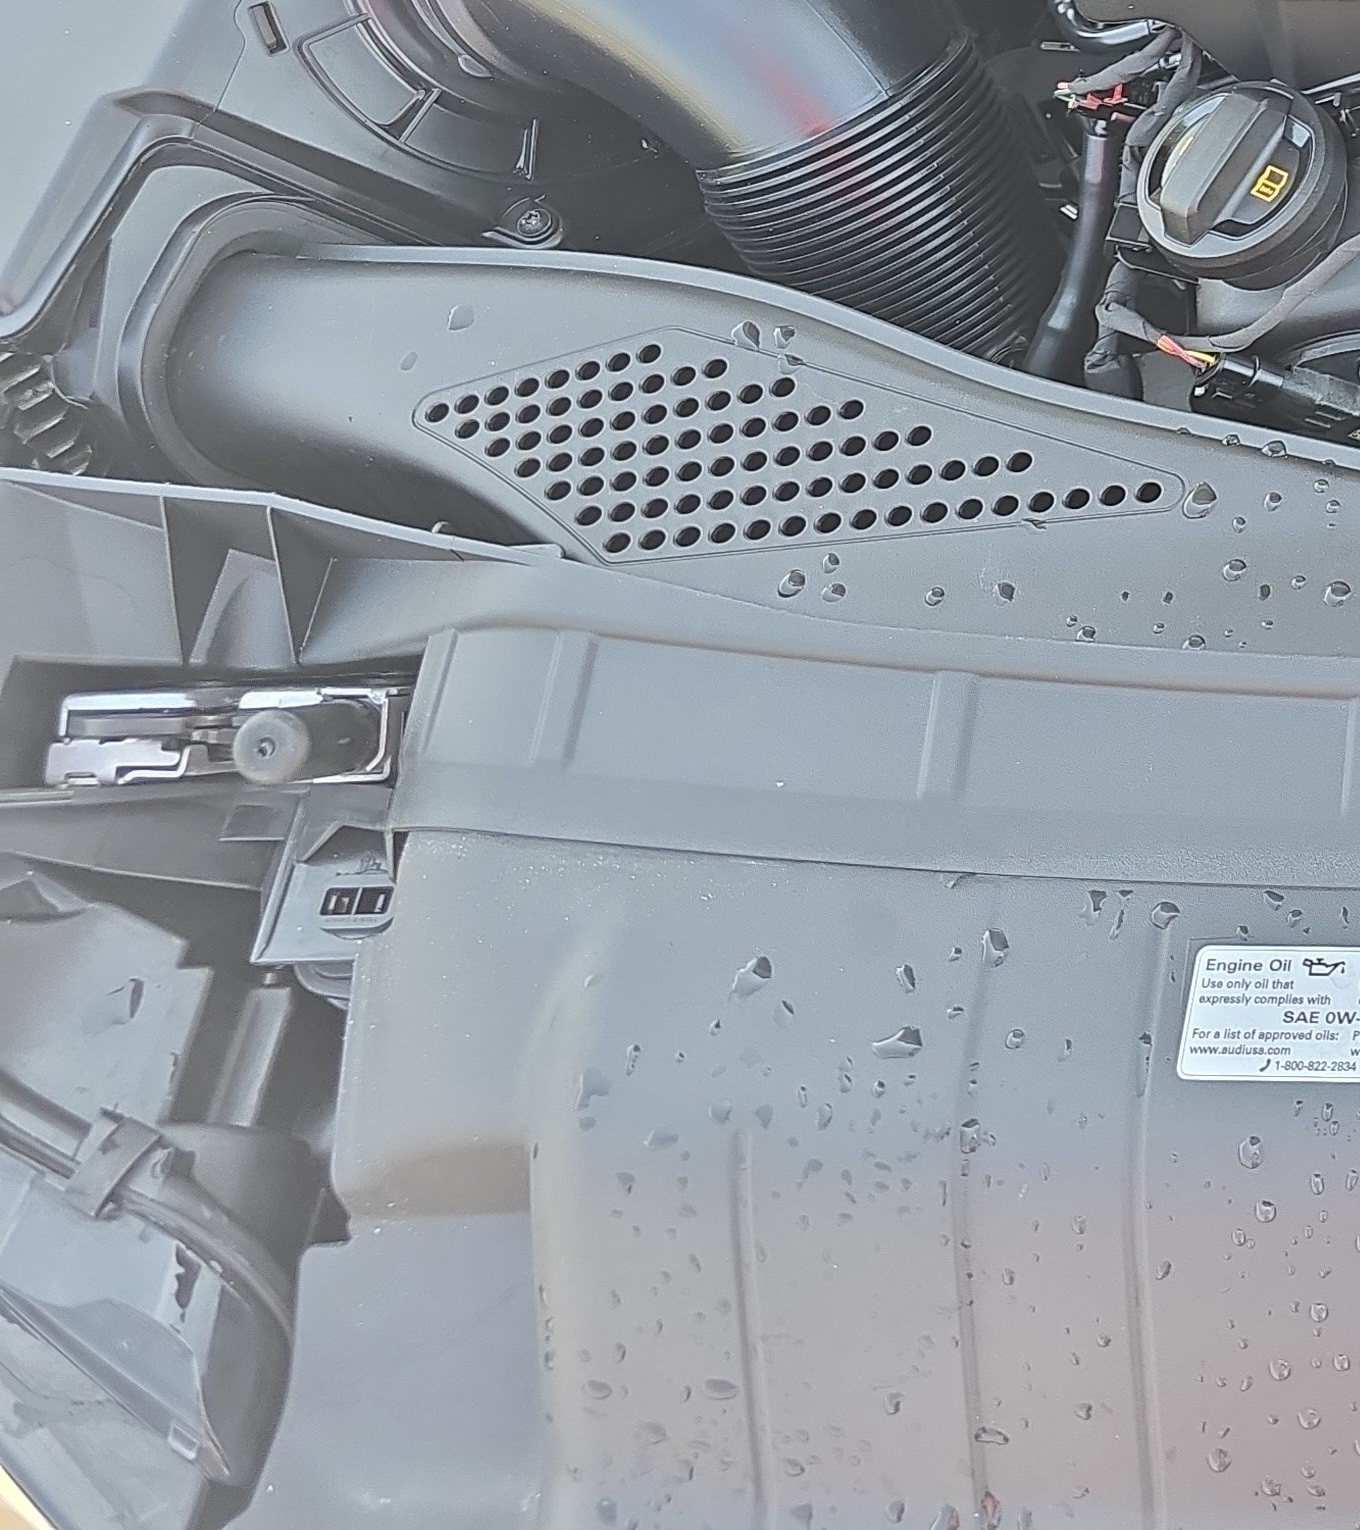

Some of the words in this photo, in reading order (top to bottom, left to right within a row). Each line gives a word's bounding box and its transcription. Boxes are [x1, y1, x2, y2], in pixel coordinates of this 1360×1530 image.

[1206, 959, 1263, 974] Engine
[1269, 959, 1292, 972] Oil
[1201, 978, 1223, 989] Use
[1226, 978, 1251, 991] only
[1254, 978, 1269, 989] oil
[1272, 979, 1294, 989] that
[1199, 993, 1251, 1006] expressly
[1254, 994, 1304, 1006] complies
[1307, 995, 1331, 1005] with
[1283, 1011, 1320, 1024] SAE
[1192, 1028, 1211, 1039] For
[1213, 1031, 1220, 1039] a
[1224, 1028, 1240, 1039] list
[1243, 1028, 1257, 1040] of
[1258, 1030, 1312, 1043] approved
[1315, 1030, 1339, 1041] oils:
[1189, 1044, 1291, 1055] www.audiusa.com
[1275, 1060, 1357, 1071] 1-800-822-2834
